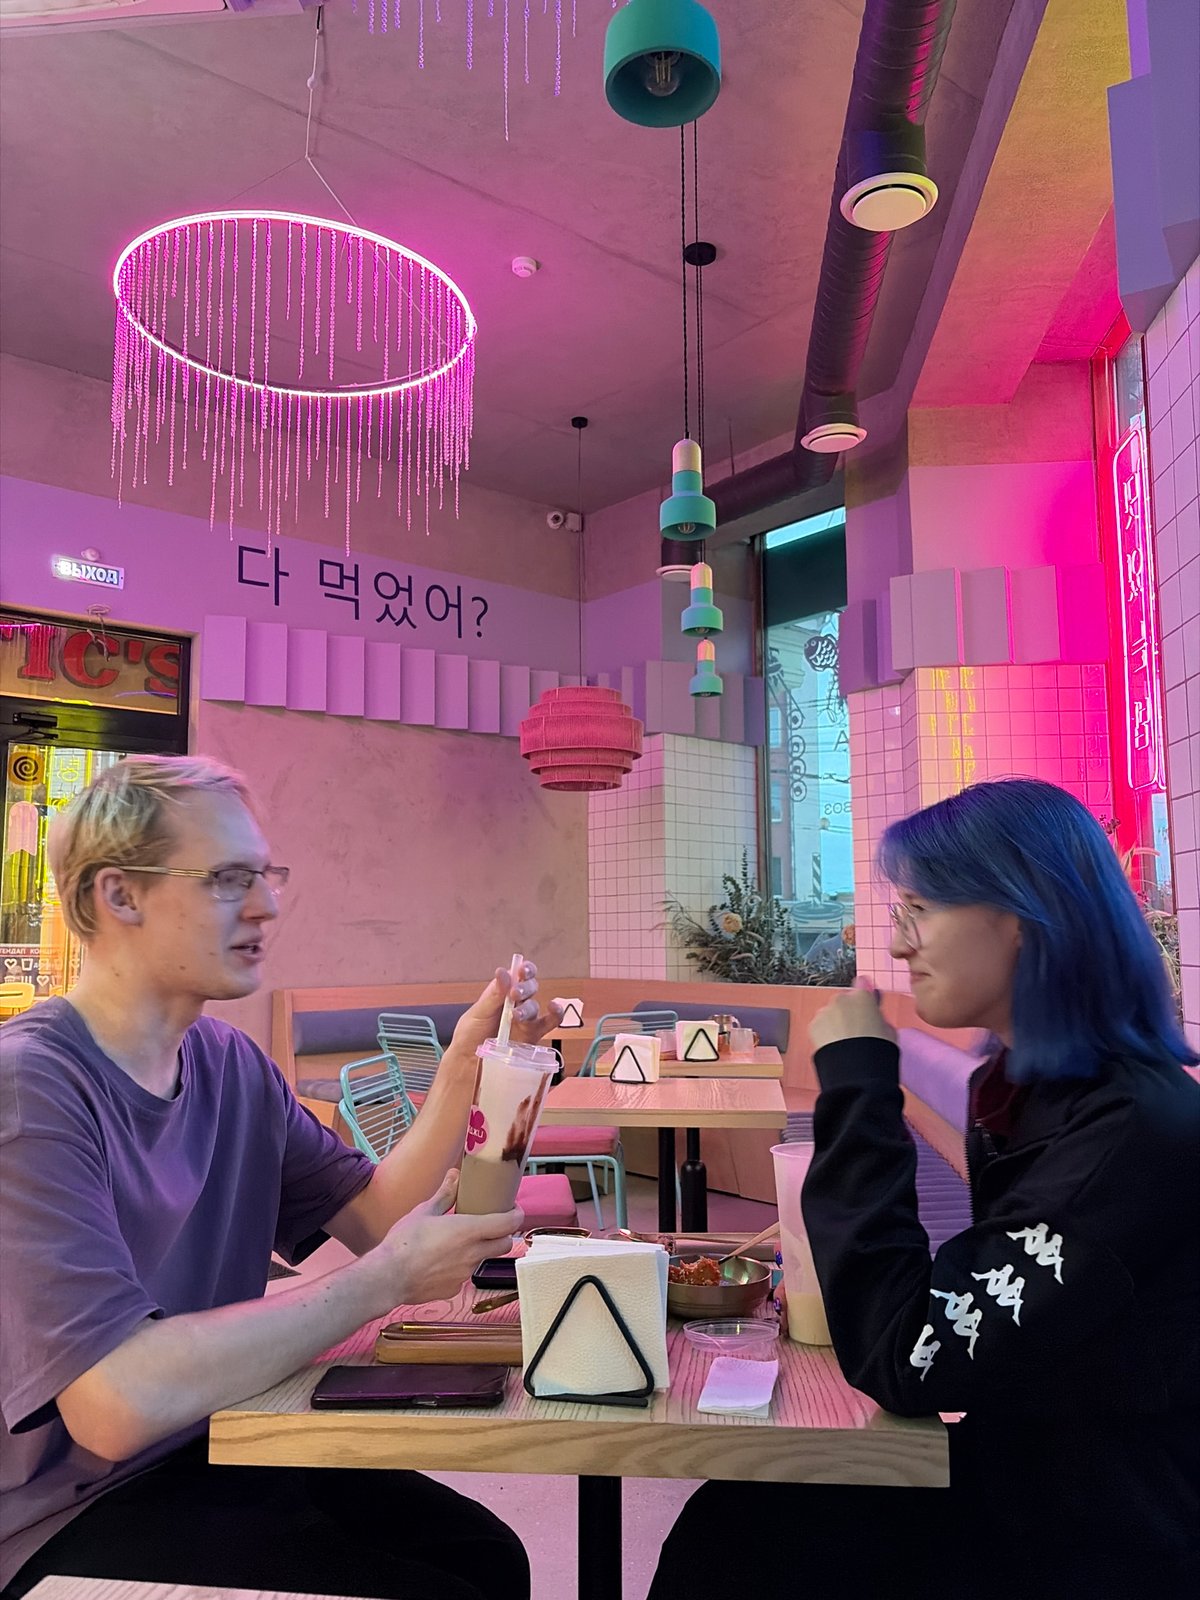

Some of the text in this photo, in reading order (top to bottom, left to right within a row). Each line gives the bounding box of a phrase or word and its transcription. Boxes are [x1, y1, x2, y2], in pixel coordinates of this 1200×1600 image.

[57, 559, 119, 586] ВЫХОД
[238, 545, 489, 639] 다 먹었어?
[0, 620, 179, 697] IC'S
